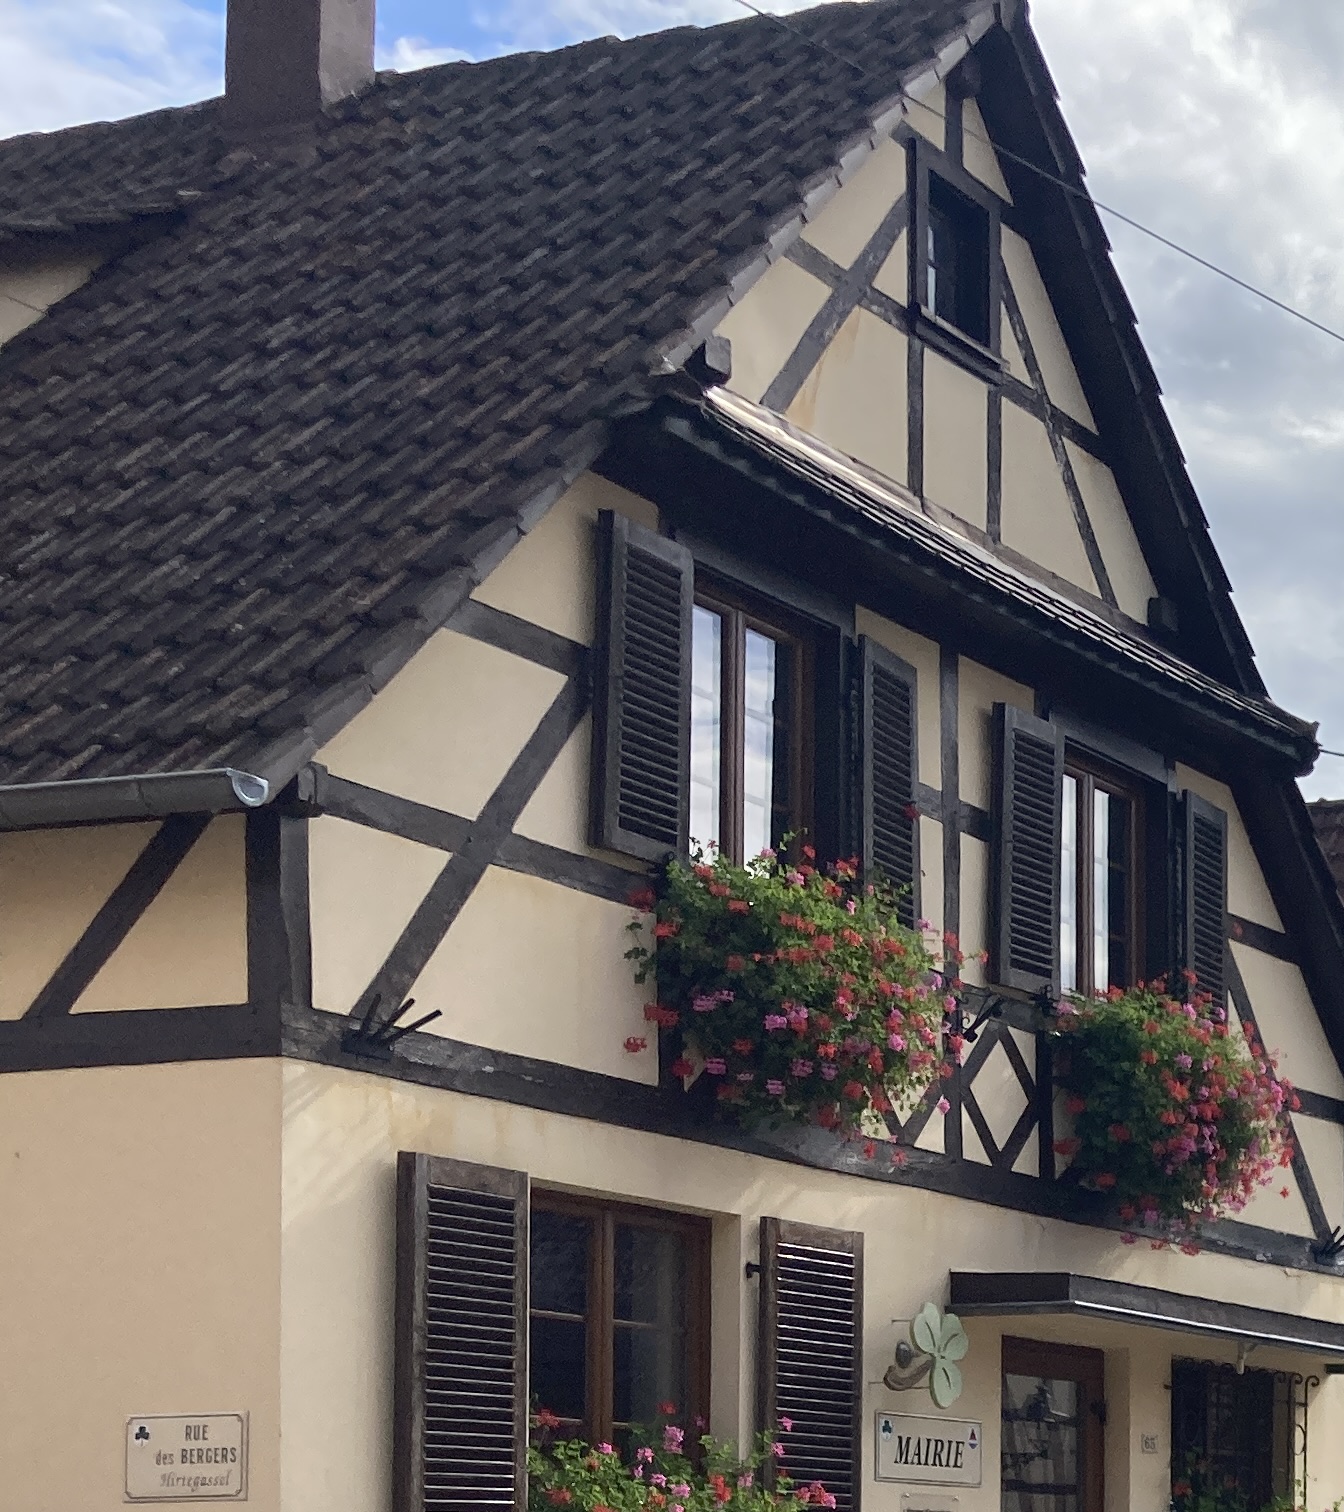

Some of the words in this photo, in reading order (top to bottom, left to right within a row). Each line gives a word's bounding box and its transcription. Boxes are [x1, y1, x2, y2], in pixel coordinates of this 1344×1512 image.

[185, 1424, 209, 1441] RUE
[155, 1449, 175, 1466] des
[181, 1447, 237, 1465] BERGERS
[894, 1435, 965, 1469] MAIRIE
